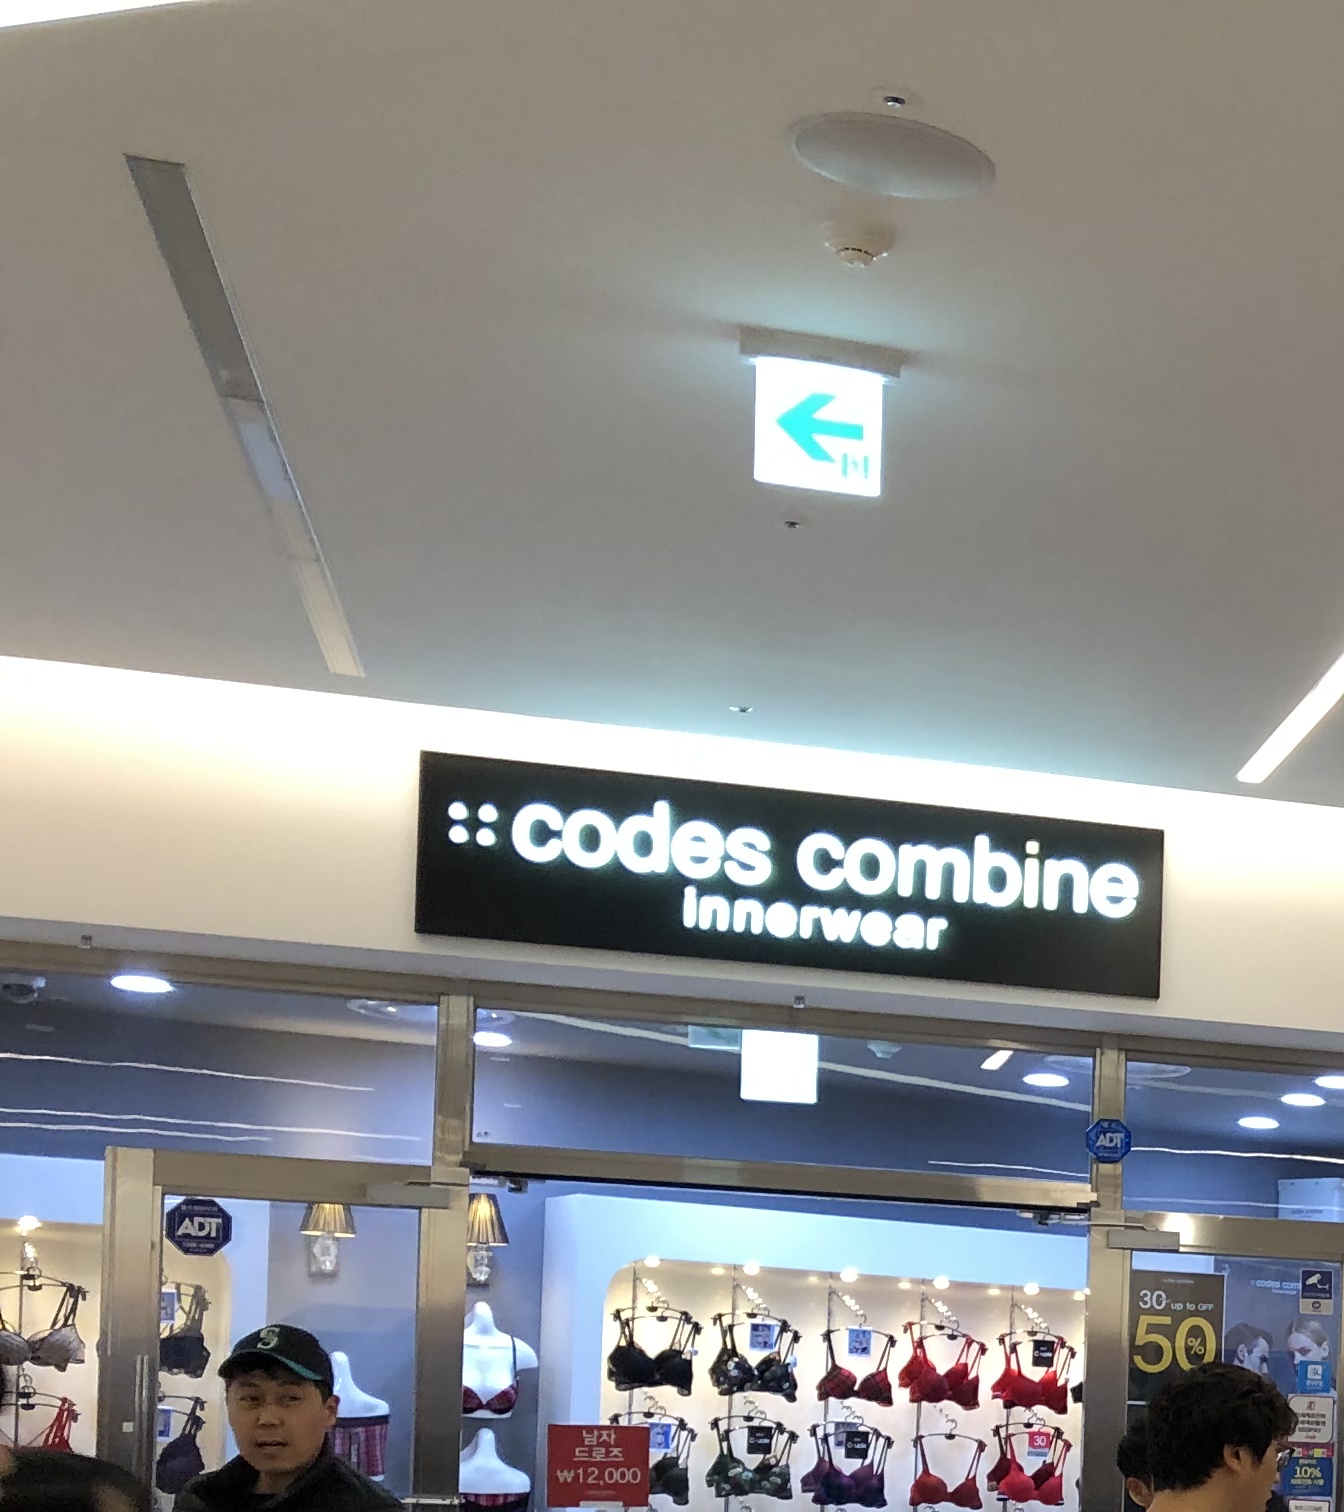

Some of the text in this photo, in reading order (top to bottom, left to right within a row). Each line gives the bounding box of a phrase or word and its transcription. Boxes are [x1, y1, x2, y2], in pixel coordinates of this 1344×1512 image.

[511, 800, 1139, 919] codes combine
[683, 885, 949, 950] innerwear
[1096, 1132, 1125, 1147] ADT
[176, 1216, 222, 1237] ADT
[1170, 1303, 1184, 1311] up
[1186, 1302, 1196, 1311] to
[1198, 1303, 1214, 1311] OFF
[257, 1327, 280, 1349] S
[582, 1428, 616, 1445] 남자
[1033, 1435, 1046, 1446] 30
[573, 1447, 625, 1461] 드로즈
[556, 1467, 641, 1486] ₩12,000
[1294, 1466, 1322, 1478] 10%
